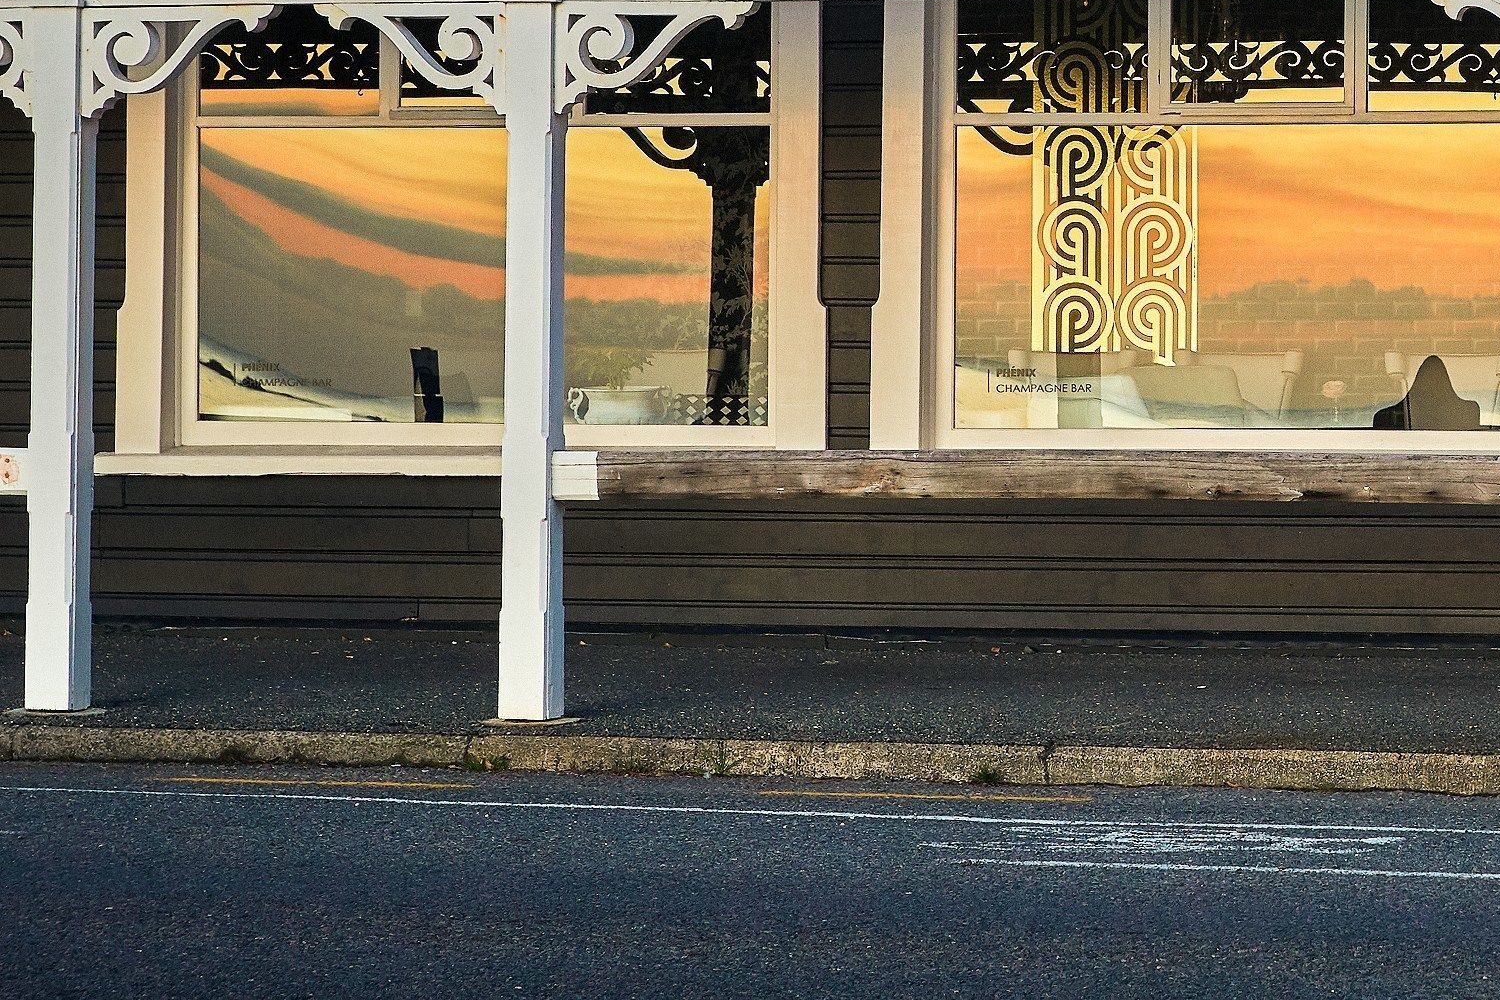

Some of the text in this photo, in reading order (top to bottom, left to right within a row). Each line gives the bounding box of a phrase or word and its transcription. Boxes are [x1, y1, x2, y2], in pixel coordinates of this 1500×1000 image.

[996, 365, 1037, 377] PHÉNIX
[312, 378, 332, 387] BAR
[996, 383, 1092, 393] CHAMPAGNE BAR
